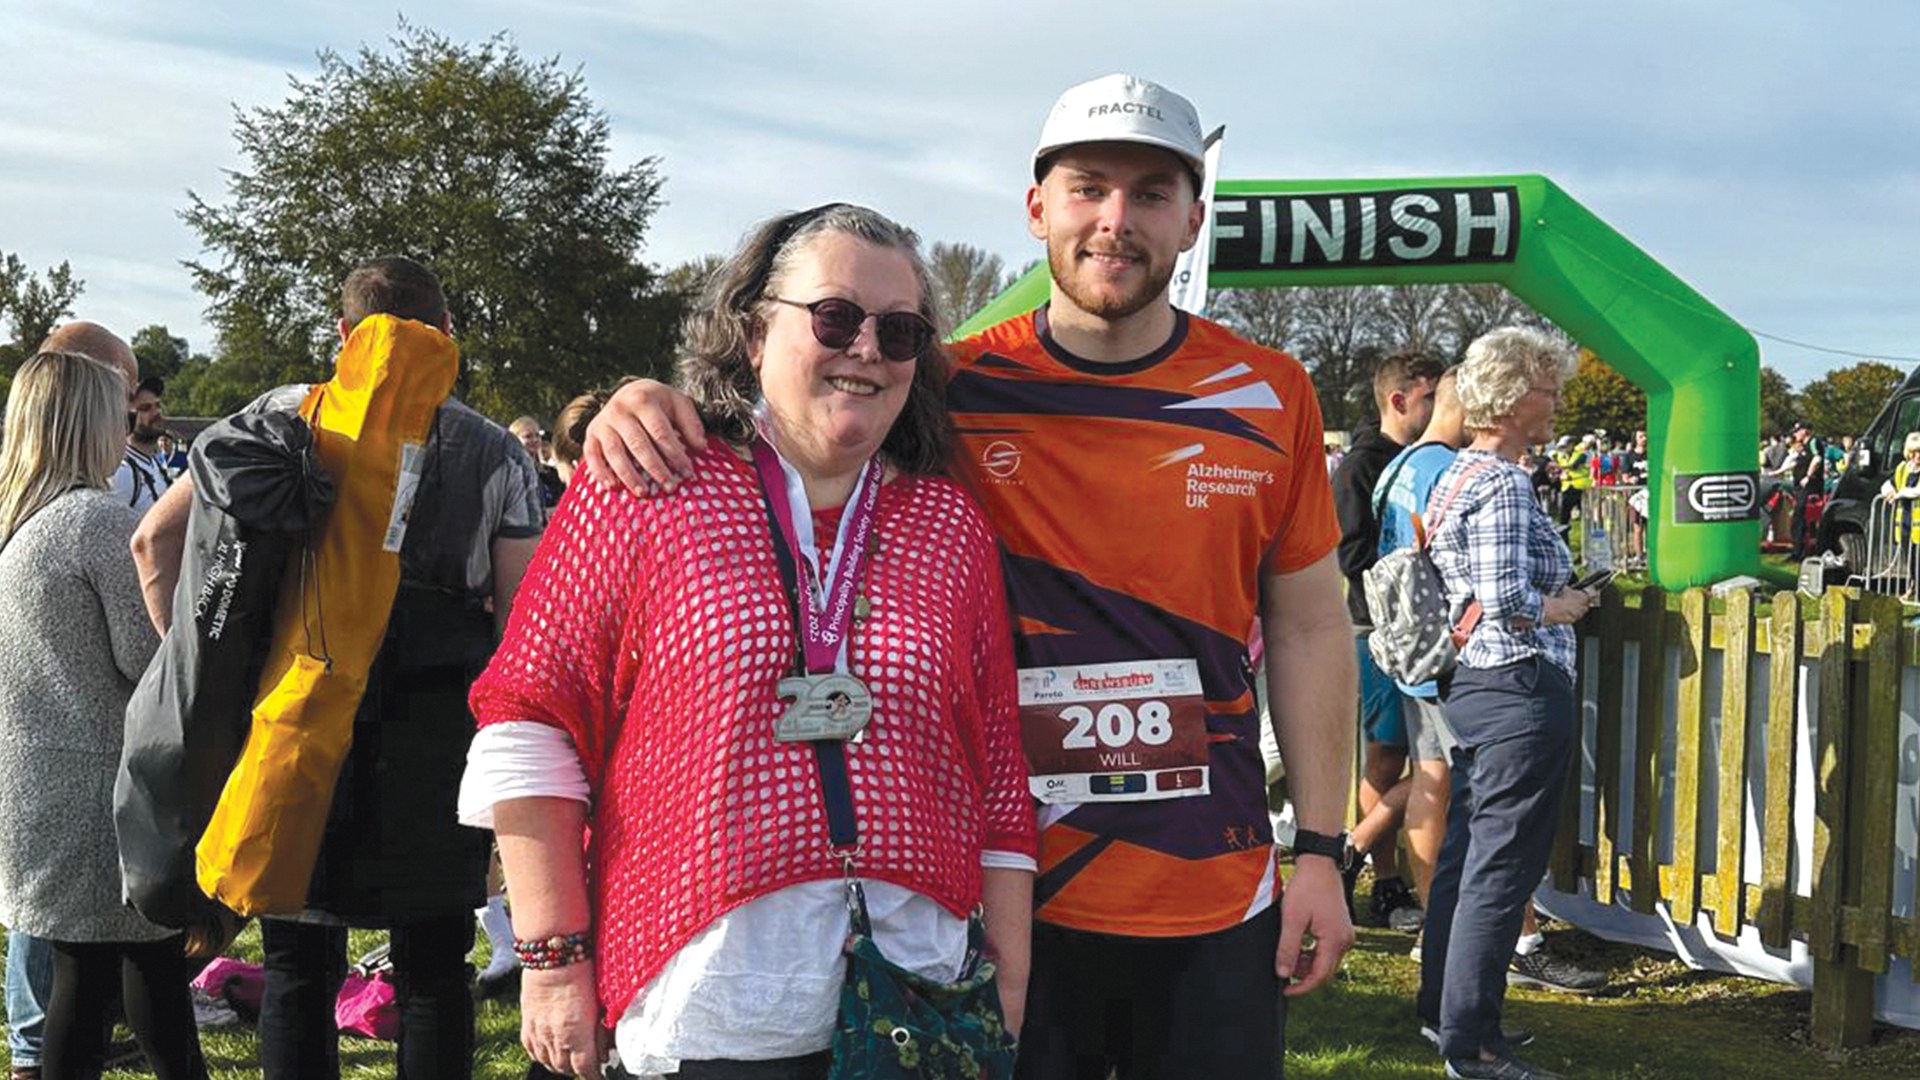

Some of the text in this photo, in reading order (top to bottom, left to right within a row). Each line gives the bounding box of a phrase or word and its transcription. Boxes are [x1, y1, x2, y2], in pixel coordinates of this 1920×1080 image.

[1088, 102, 1165, 122] FRACTEL
[1209, 192, 1512, 265] FINISH
[1187, 463, 1275, 484] Alzheimer's
[1187, 479, 1257, 497] Research
[1185, 494, 1210, 509] UK
[853, 514, 871, 545] Society
[843, 544, 864, 579] Building
[194, 584, 214, 621] BACK
[209, 588, 234, 640] DOMETIC
[829, 578, 853, 631] Principality
[1058, 701, 1173, 749] 208
[1099, 752, 1141, 767] WILL
